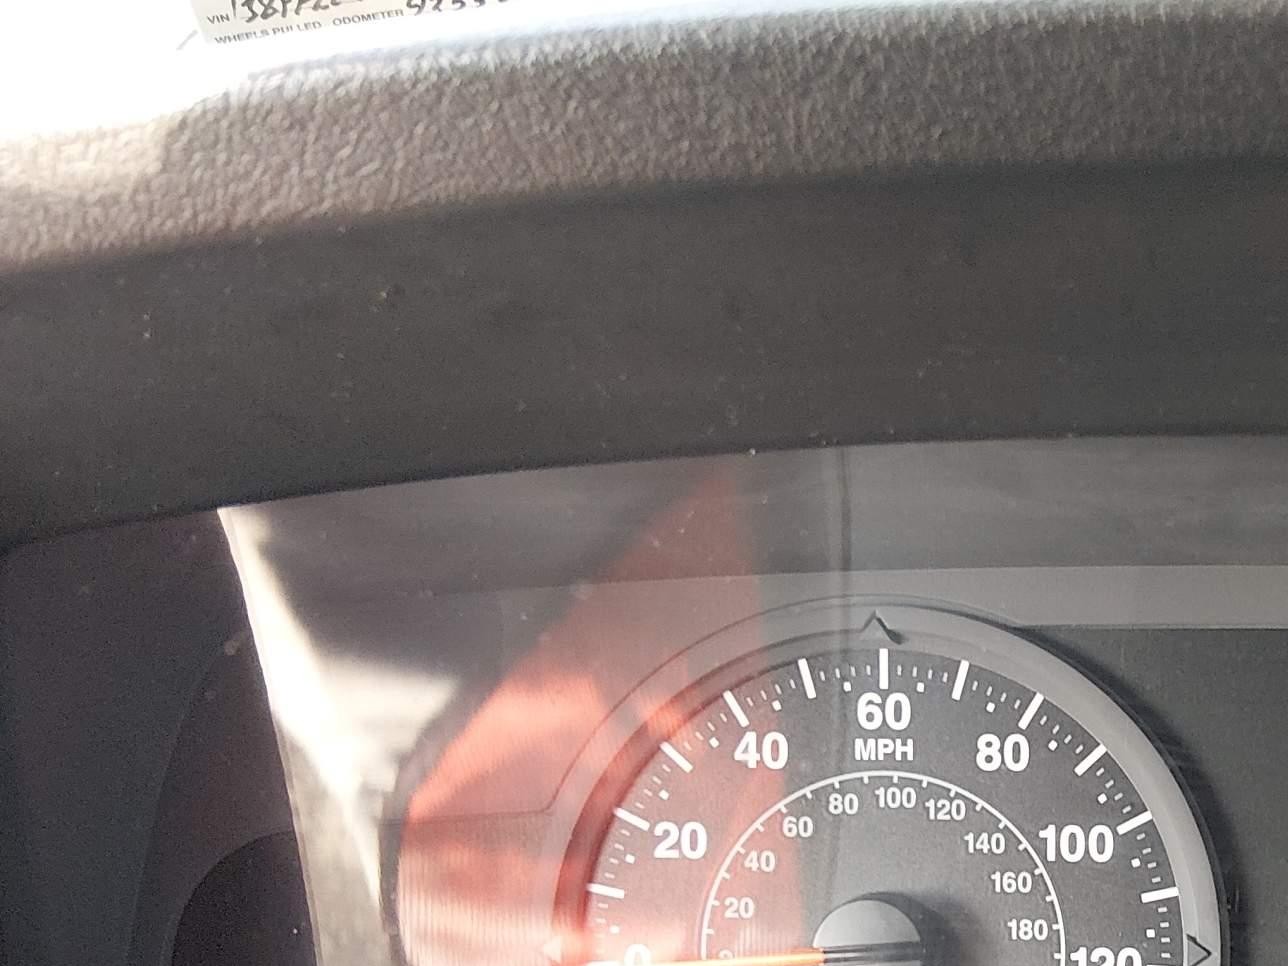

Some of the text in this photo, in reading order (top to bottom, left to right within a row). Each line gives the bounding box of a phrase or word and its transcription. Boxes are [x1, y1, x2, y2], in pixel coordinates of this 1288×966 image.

[207, 13, 230, 25] VIN
[332, 9, 405, 26] ODOMETER
[856, 693, 912, 732] 60
[733, 731, 789, 769] 40
[854, 739, 914, 761] MPH
[975, 734, 1031, 772] 80
[828, 793, 859, 815] 80
[874, 787, 917, 809] 100
[924, 798, 967, 822] 120
[782, 816, 814, 838] 60
[653, 822, 708, 860] 20
[964, 832, 1006, 855] 140
[1039, 824, 1115, 863] 100
[743, 850, 777, 873] 40
[991, 871, 1033, 894] 160
[724, 897, 754, 919] 20
[1007, 918, 1049, 941] 180
